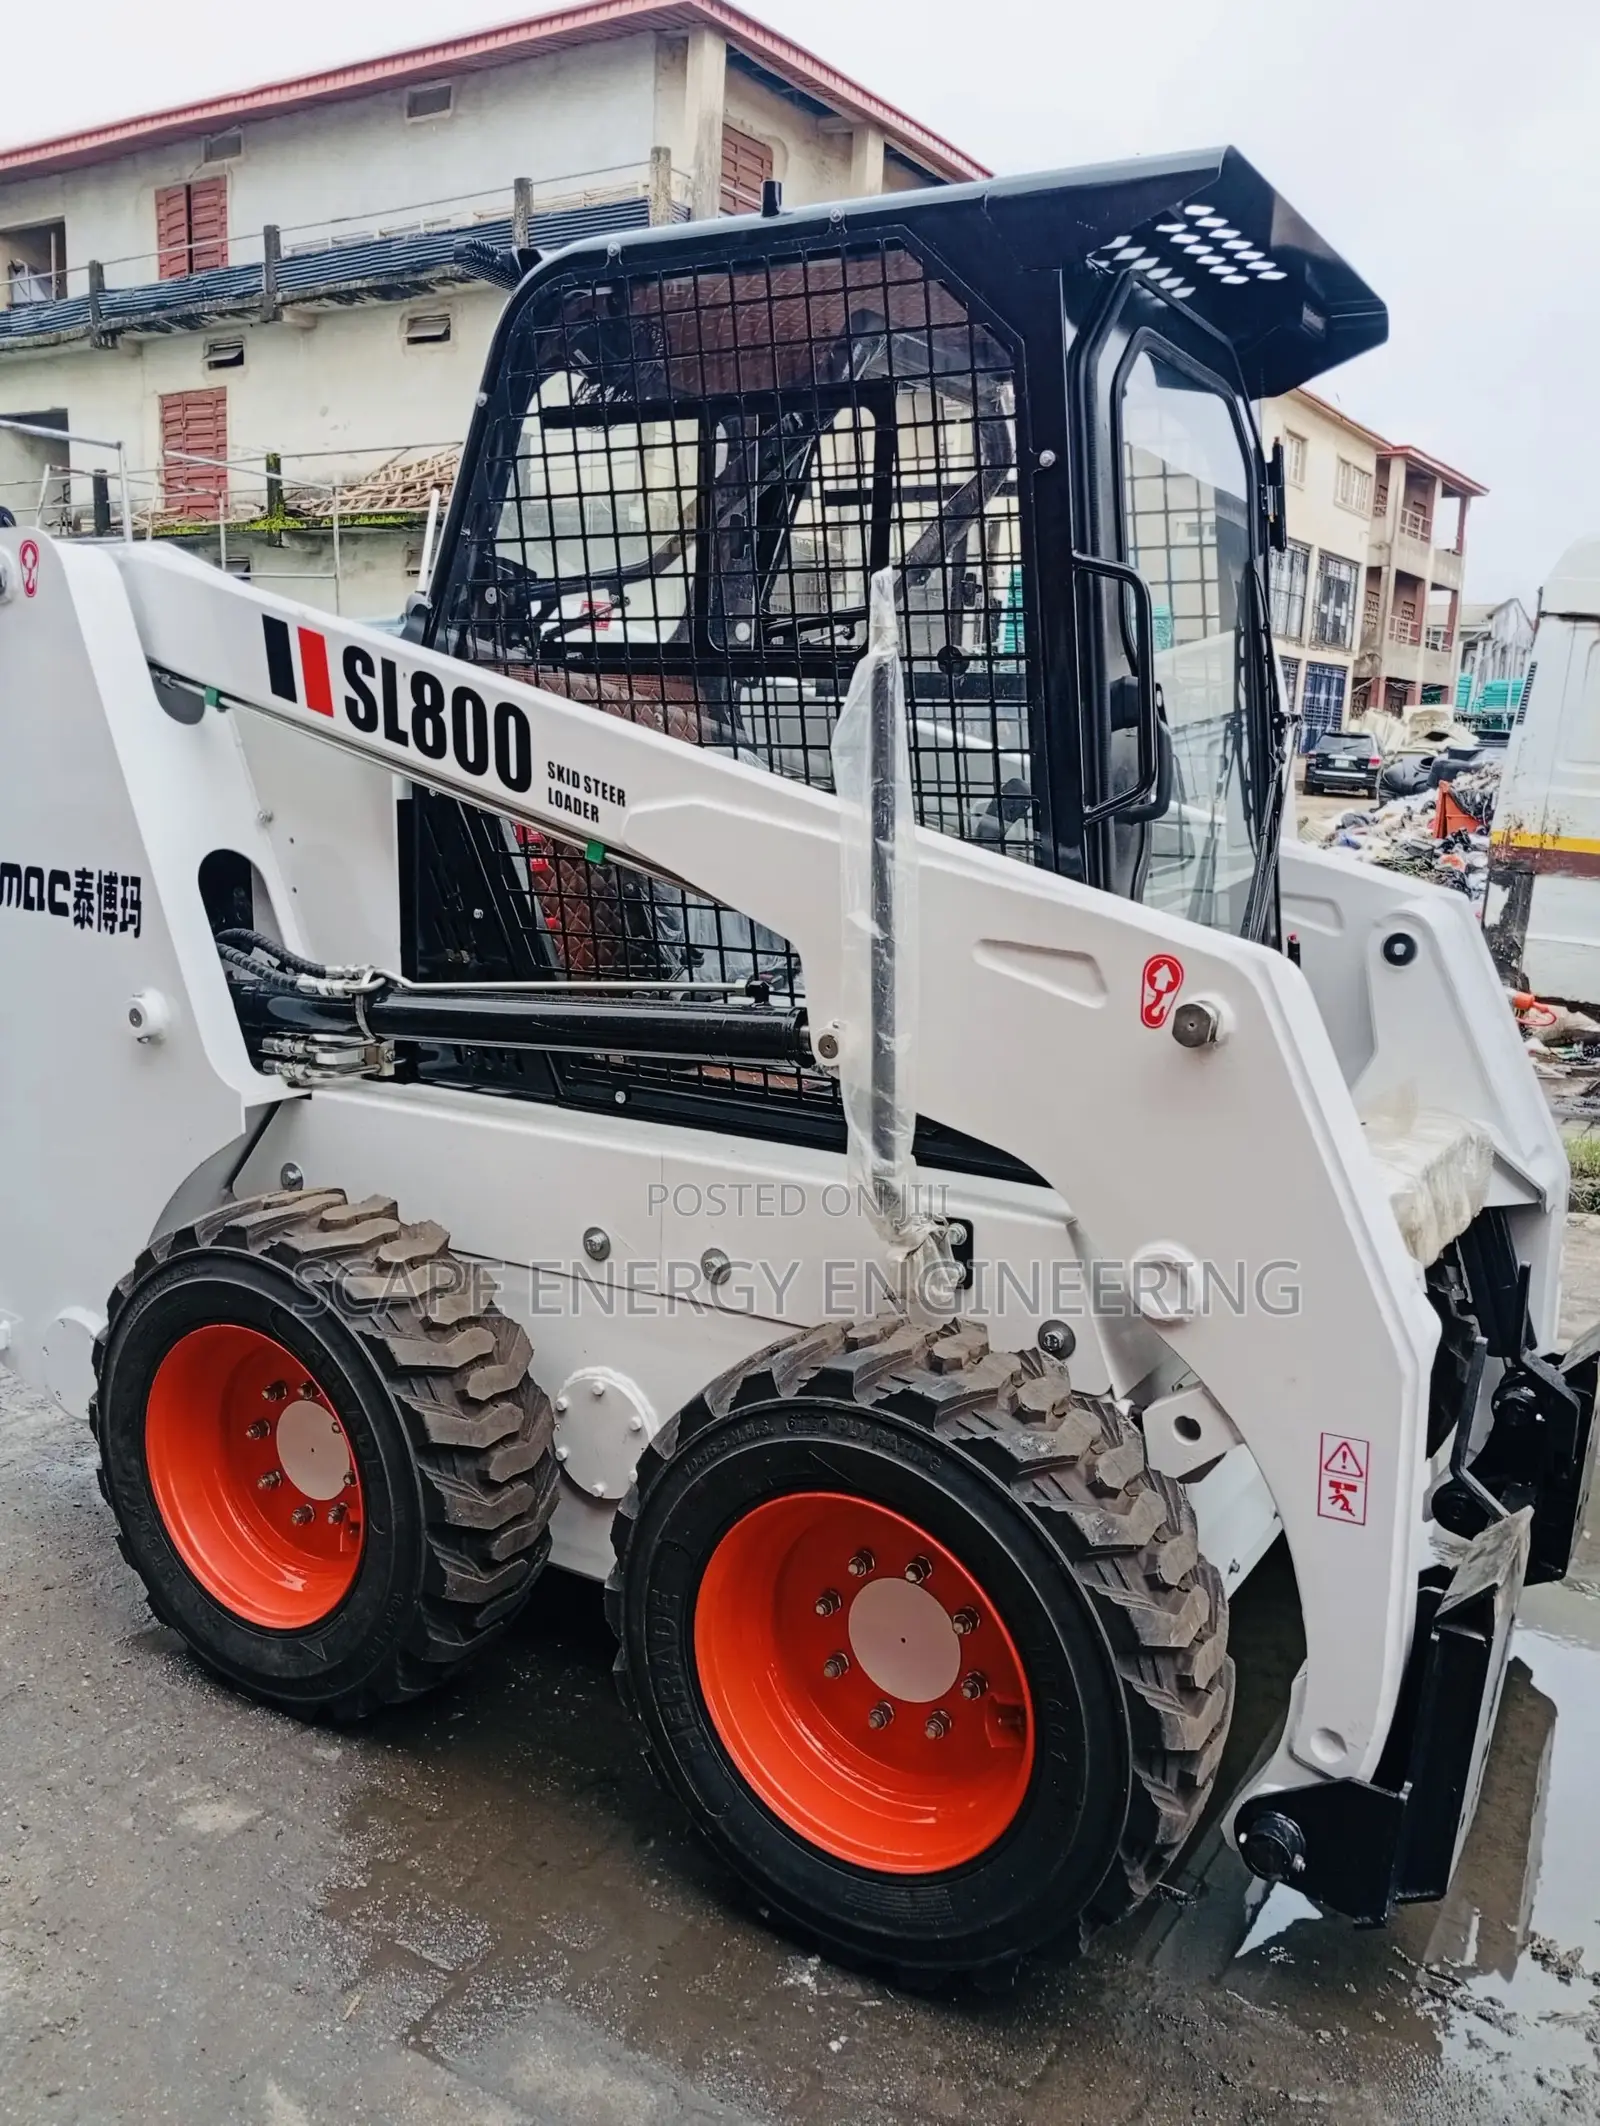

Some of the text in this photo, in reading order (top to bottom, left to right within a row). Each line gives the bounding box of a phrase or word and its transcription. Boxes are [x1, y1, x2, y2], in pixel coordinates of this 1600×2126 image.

[342, 646, 532, 793] SL800
[548, 761, 626, 807] SKID STEER
[548, 787, 600, 823] LOADER
[73, 867, 142, 938] 泰博玛
